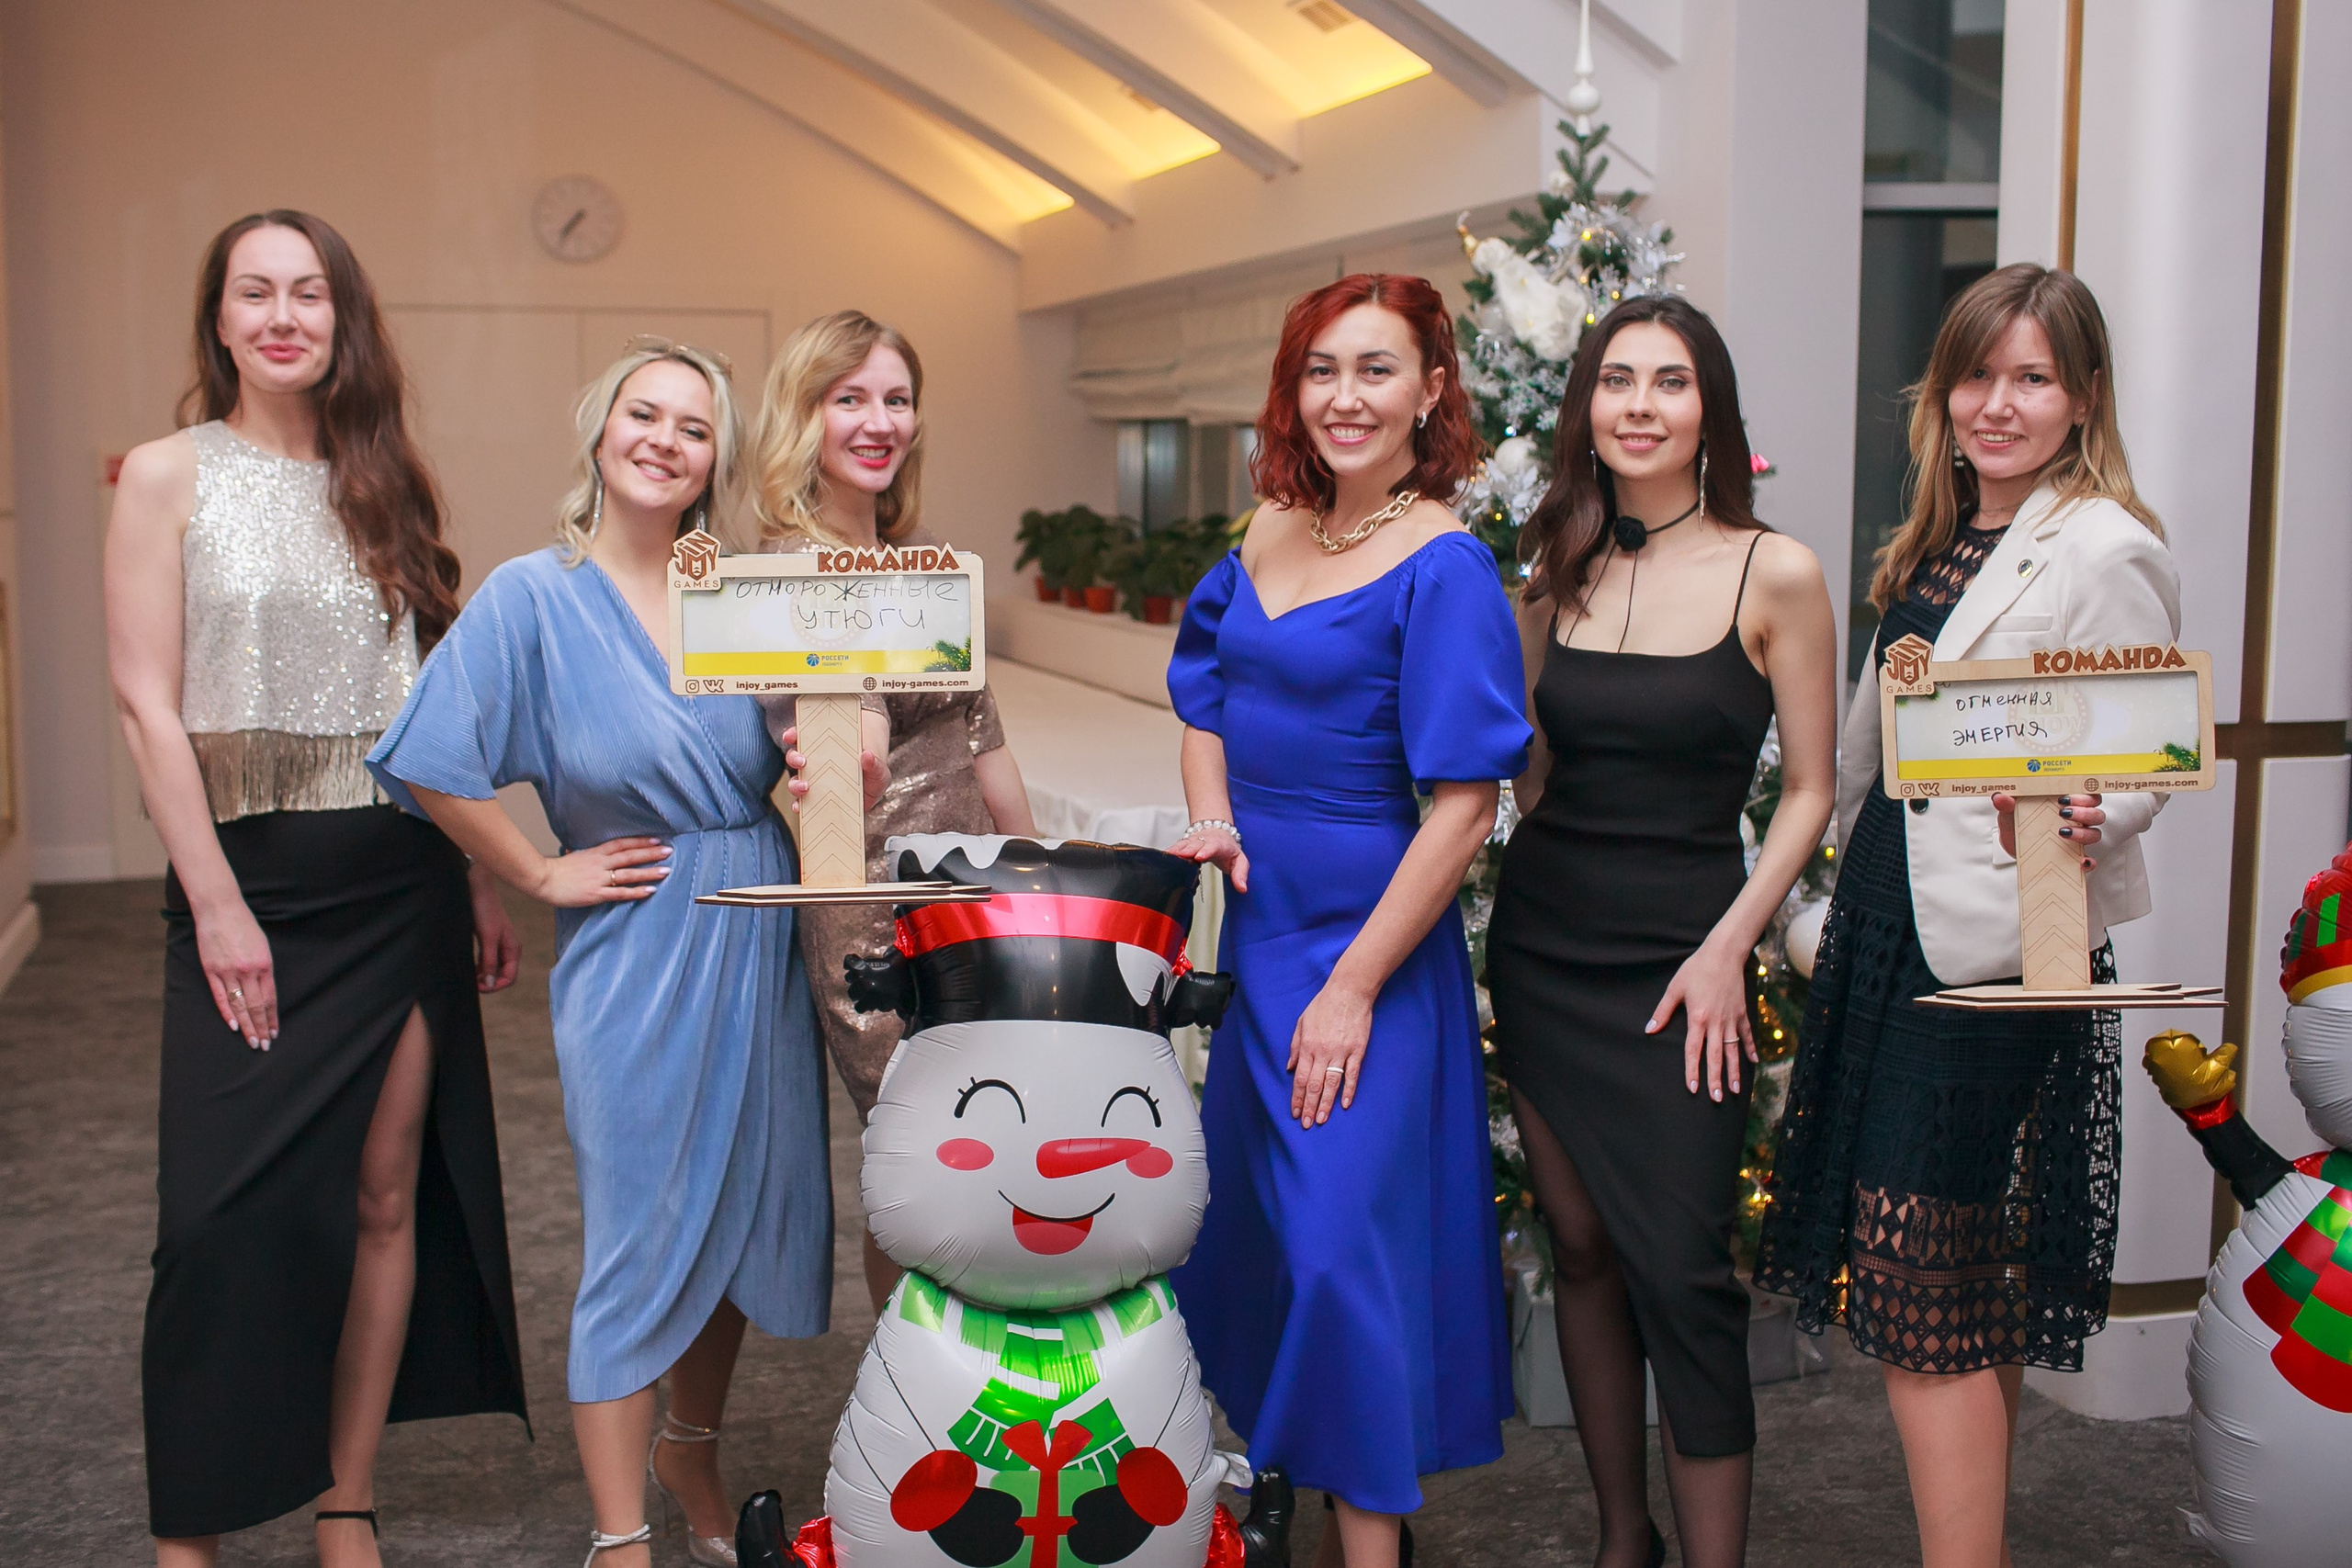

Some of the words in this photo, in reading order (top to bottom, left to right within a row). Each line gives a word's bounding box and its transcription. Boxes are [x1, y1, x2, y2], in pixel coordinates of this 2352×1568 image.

[818, 549, 960, 573] КОМАНДА
[673, 580, 719, 589] GAMES
[797, 604, 926, 629] УТЮГИ
[2033, 645, 2187, 675] КОМАНДА
[736, 681, 798, 691] injoy_games
[882, 680, 969, 689] injoy-games.com
[1886, 683, 1932, 694] GAMES
[1951, 783, 2017, 794] injoy_games
[2104, 780, 2199, 790] injoy-games.com
